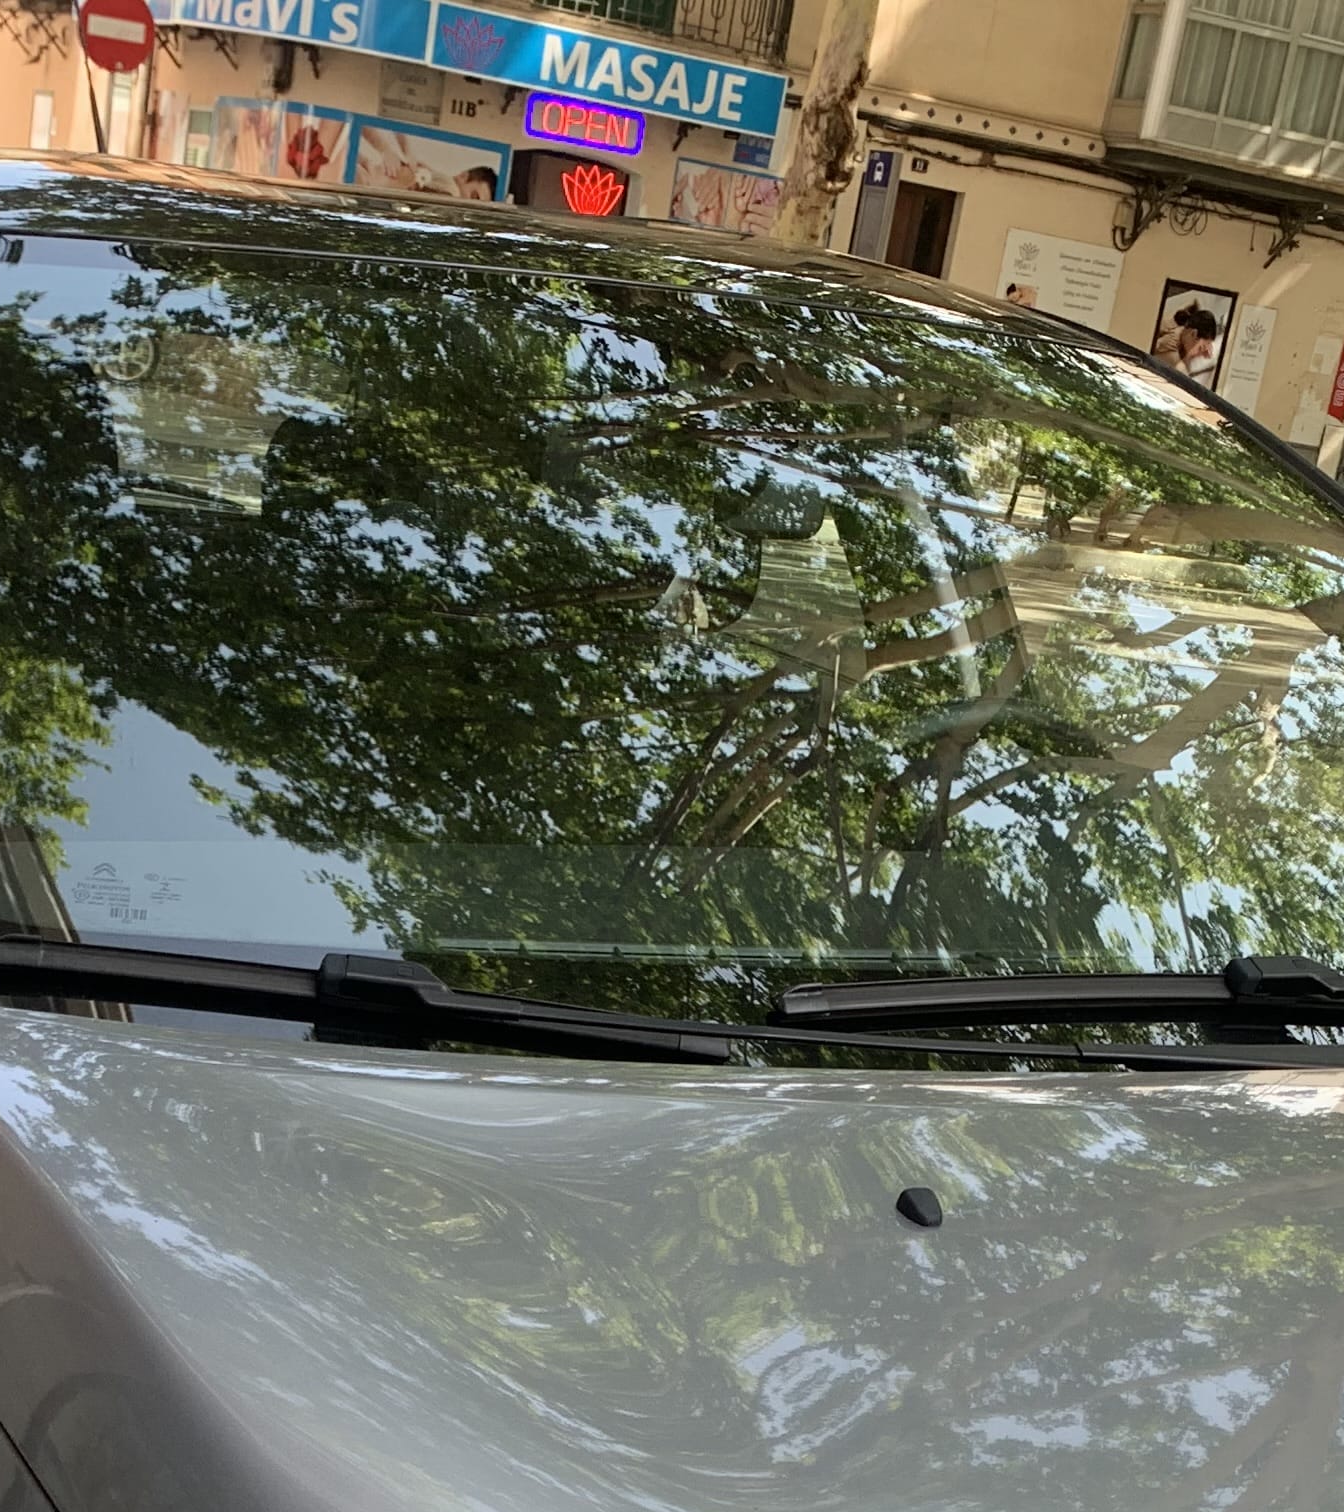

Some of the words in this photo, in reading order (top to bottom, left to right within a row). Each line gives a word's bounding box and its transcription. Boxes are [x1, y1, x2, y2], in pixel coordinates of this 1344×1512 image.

[197, 0, 359, 43] avis
[540, 34, 747, 121] MASAJE
[542, 101, 630, 147] OPEN
